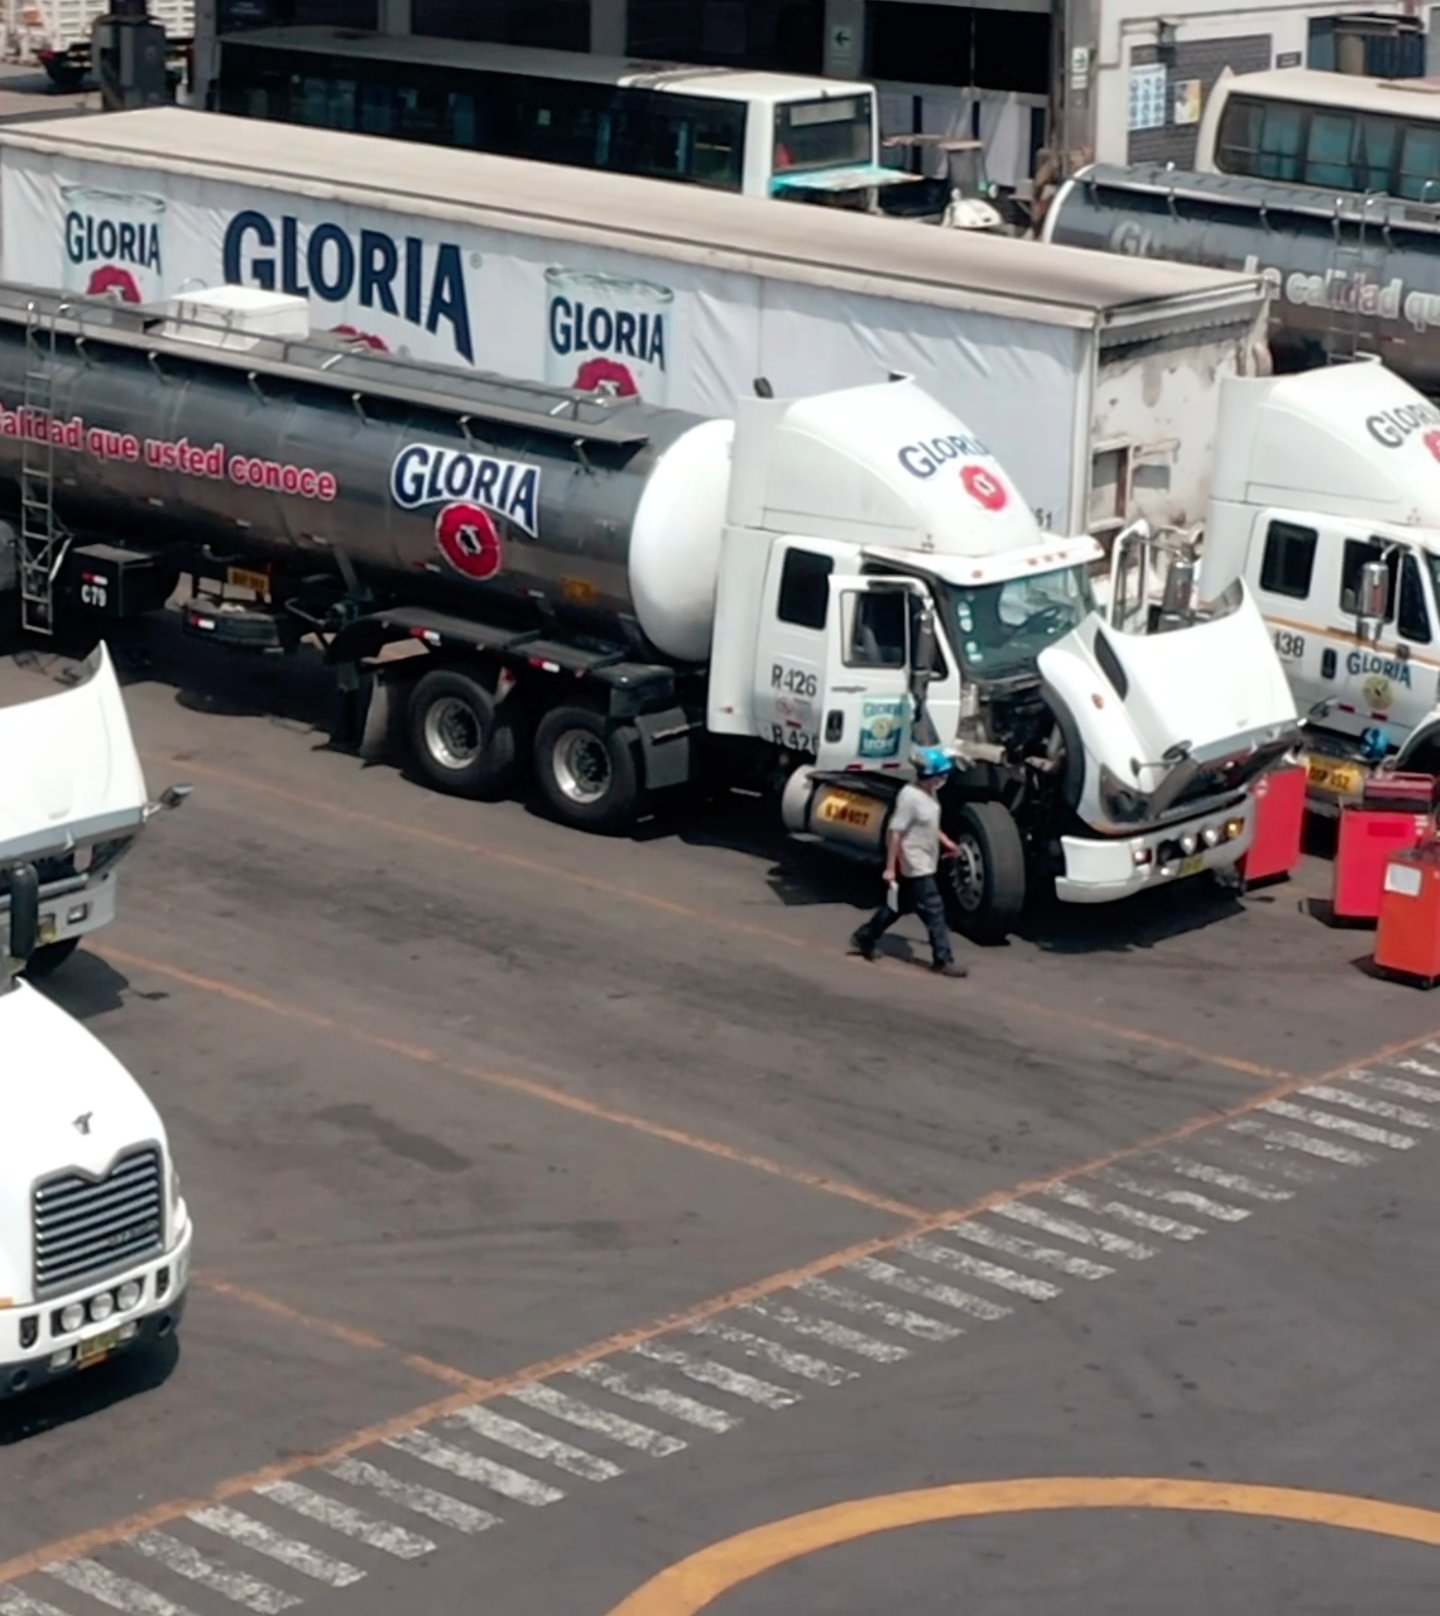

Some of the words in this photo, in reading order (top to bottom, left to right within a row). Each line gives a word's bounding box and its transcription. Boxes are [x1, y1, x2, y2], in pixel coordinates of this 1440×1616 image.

[65, 210, 162, 277] GLORIA
[223, 210, 475, 365] GLORIA
[550, 295, 666, 372] GLORIA
[87, 427, 139, 463] que
[144, 436, 227, 480] usted
[228, 453, 338, 501] conoce
[393, 445, 539, 535] GLORIA
[1346, 652, 1414, 690] GLORIA
